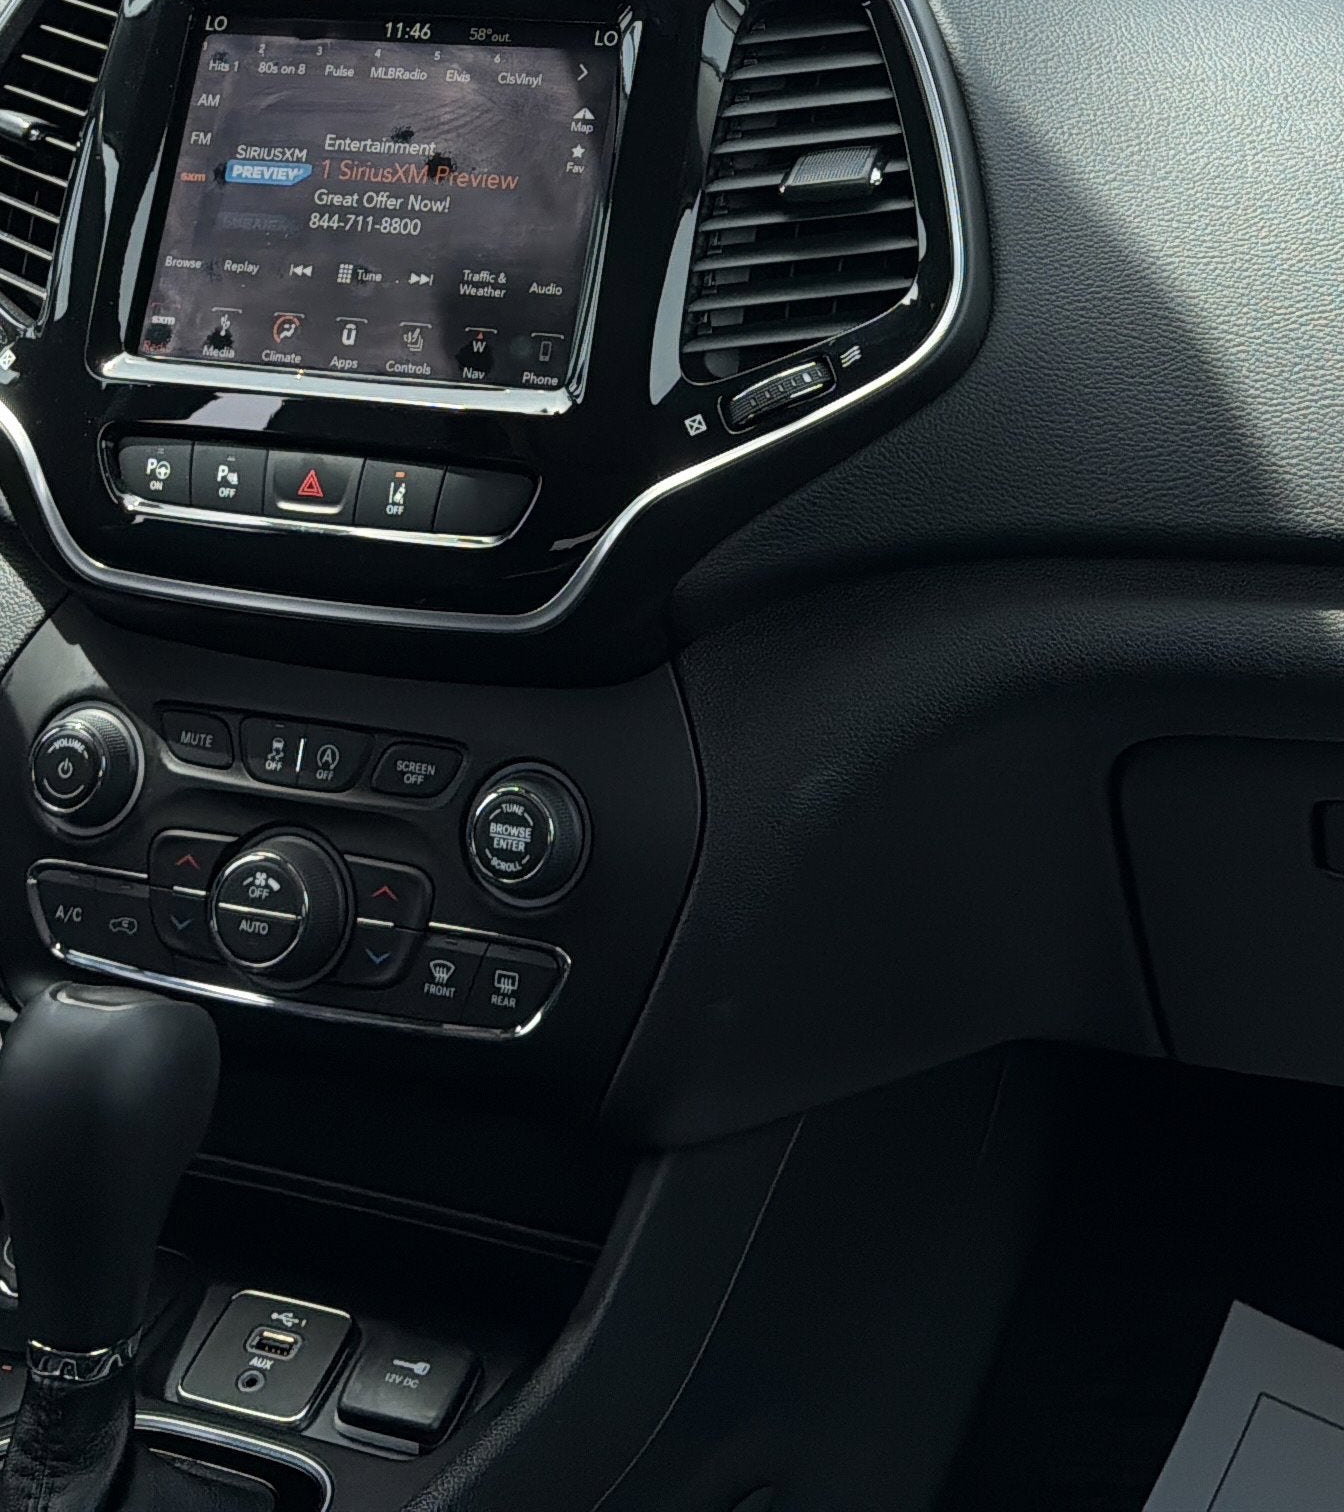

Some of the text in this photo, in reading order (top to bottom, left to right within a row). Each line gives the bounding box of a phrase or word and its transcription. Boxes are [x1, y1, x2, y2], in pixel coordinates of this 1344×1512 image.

[206, 15, 227, 31] LO
[385, 22, 432, 39] 11:46
[594, 30, 619, 46] LO
[258, 43, 266, 54] 2
[316, 46, 323, 56] 3
[374, 48, 382, 58] 4
[433, 51, 441, 61] 5
[493, 54, 501, 64] 6
[208, 59, 240, 73] Hits 1
[258, 61, 306, 75] 80s on 8
[325, 64, 355, 77] Pulse
[370, 66, 427, 81] MLBRadio
[446, 69, 471, 82] Elvis
[197, 94, 221, 107] AM
[570, 121, 594, 135] Map
[190, 132, 212, 146] FM
[325, 134, 436, 156] Entertainment
[236, 145, 307, 162] SIRIUSXM
[322, 159, 519, 190] 1 SiriusXM Preview
[566, 162, 585, 174] Fav
[180, 172, 207, 182] sxm
[314, 189, 451, 212] Great Offer Now!
[309, 212, 421, 235] 844-711-8800
[165, 256, 203, 269] Browse
[224, 259, 260, 275] Replay
[357, 269, 383, 282] Tune
[462, 269, 507, 284] Traffic &
[459, 284, 506, 298] Weather
[529, 282, 563, 296] Audio
[151, 315, 176, 325] sxm
[202, 344, 235, 359] Media
[472, 341, 486, 353] W
[261, 349, 302, 364] Climate
[329, 355, 358, 369] Apps
[385, 360, 432, 375] Controls
[462, 367, 485, 380] Nav
[522, 371, 559, 386] Phone
[149, 480, 164, 491] ON
[218, 487, 236, 499] OFF
[385, 503, 405, 515] OFF
[53, 738, 85, 752] VOLUME
[180, 730, 213, 748] MUTE
[265, 760, 282, 771] OFF
[396, 760, 435, 776] SCREEN
[316, 769, 334, 781] OFF
[403, 773, 425, 785] OFF
[501, 803, 525, 816] TUNE
[489, 822, 532, 838] BROWSE
[493, 837, 525, 852] ENTER
[490, 857, 522, 872] SCROLL
[248, 888, 270, 900] OFF
[56, 904, 82, 923] A/C
[239, 919, 269, 935] AUTO
[423, 982, 456, 998] FRONT
[491, 994, 516, 1008] REAR
[249, 1356, 274, 1371] AUX
